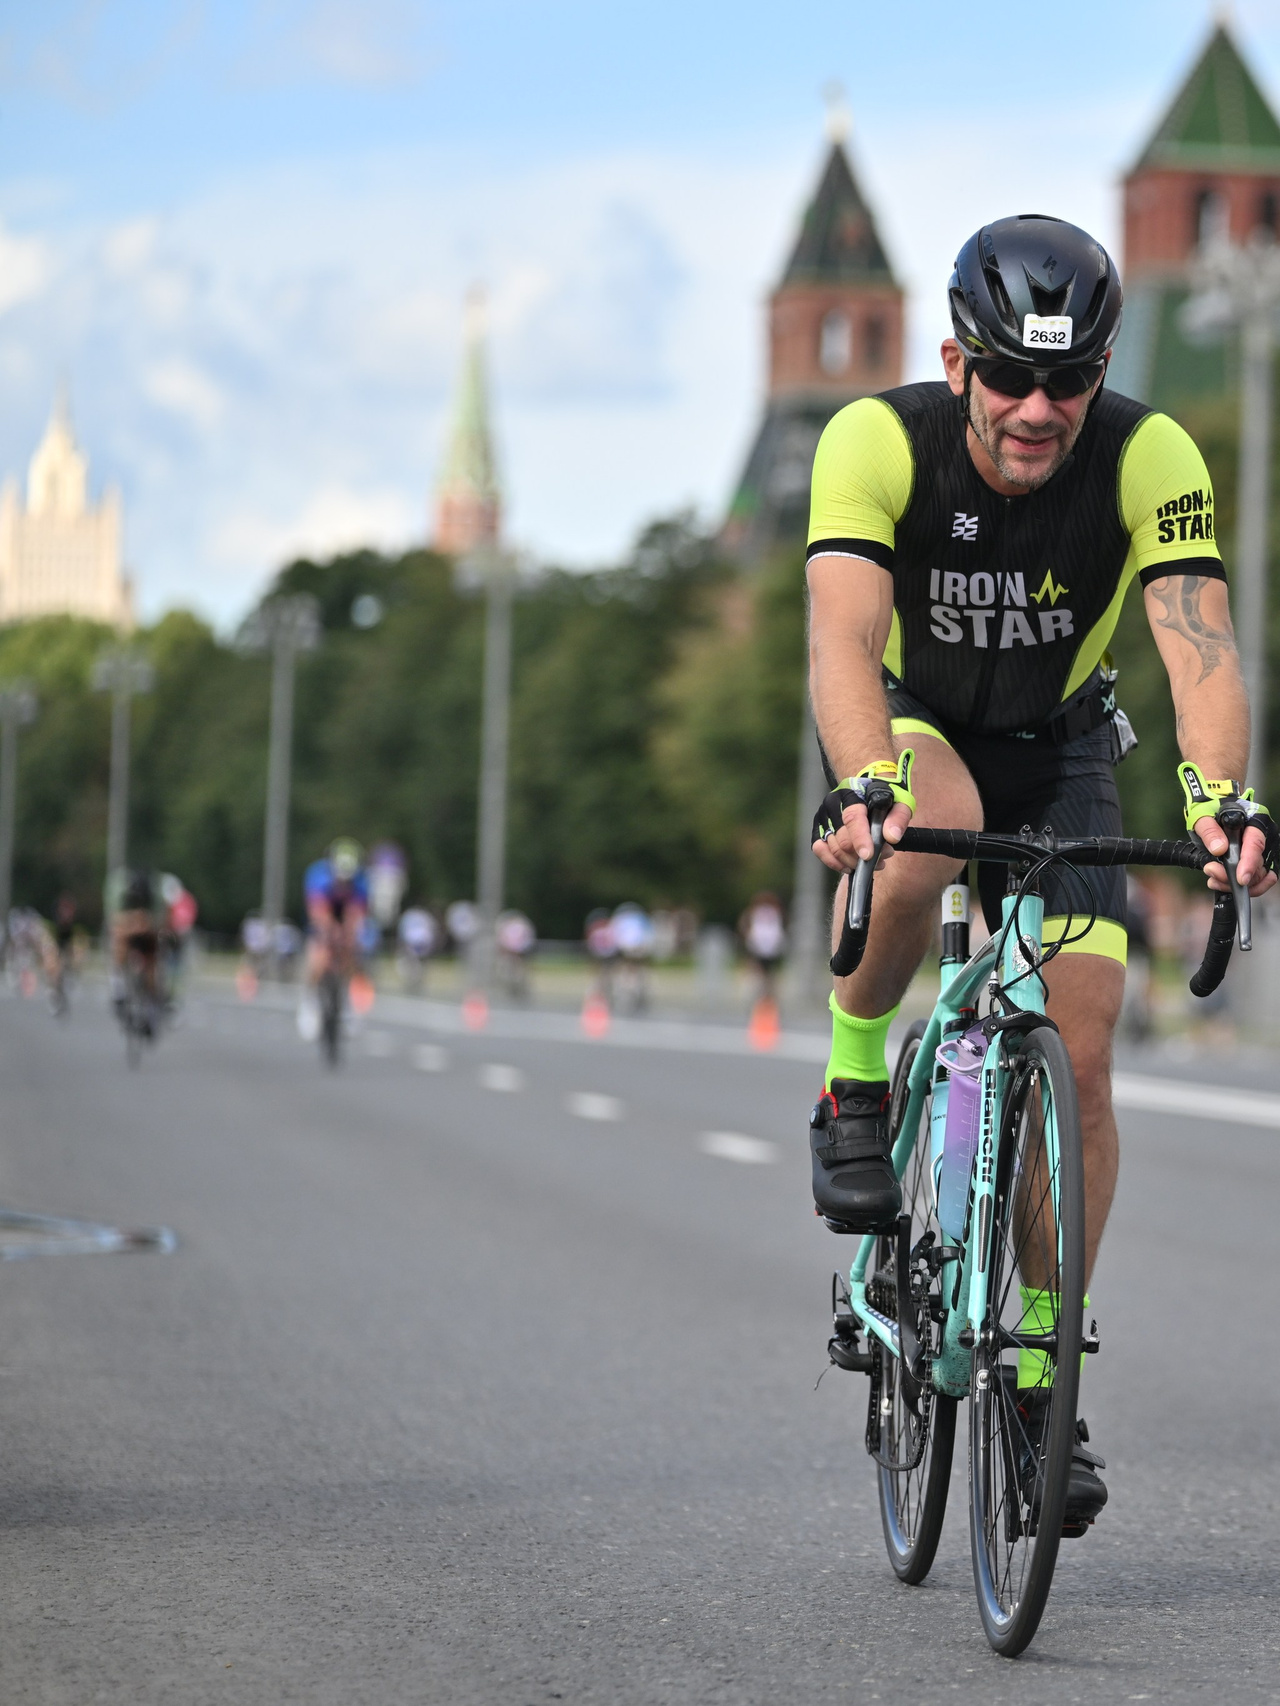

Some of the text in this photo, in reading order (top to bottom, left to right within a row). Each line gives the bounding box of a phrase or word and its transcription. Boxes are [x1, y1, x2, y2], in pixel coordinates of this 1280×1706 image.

[1029, 329, 1067, 344] 2632
[1156, 489, 1204, 520] IRON
[1158, 513, 1213, 544] STAR
[929, 568, 1028, 608] IRON
[930, 604, 1075, 649] STAR
[981, 1068, 997, 1186] Bianchi
